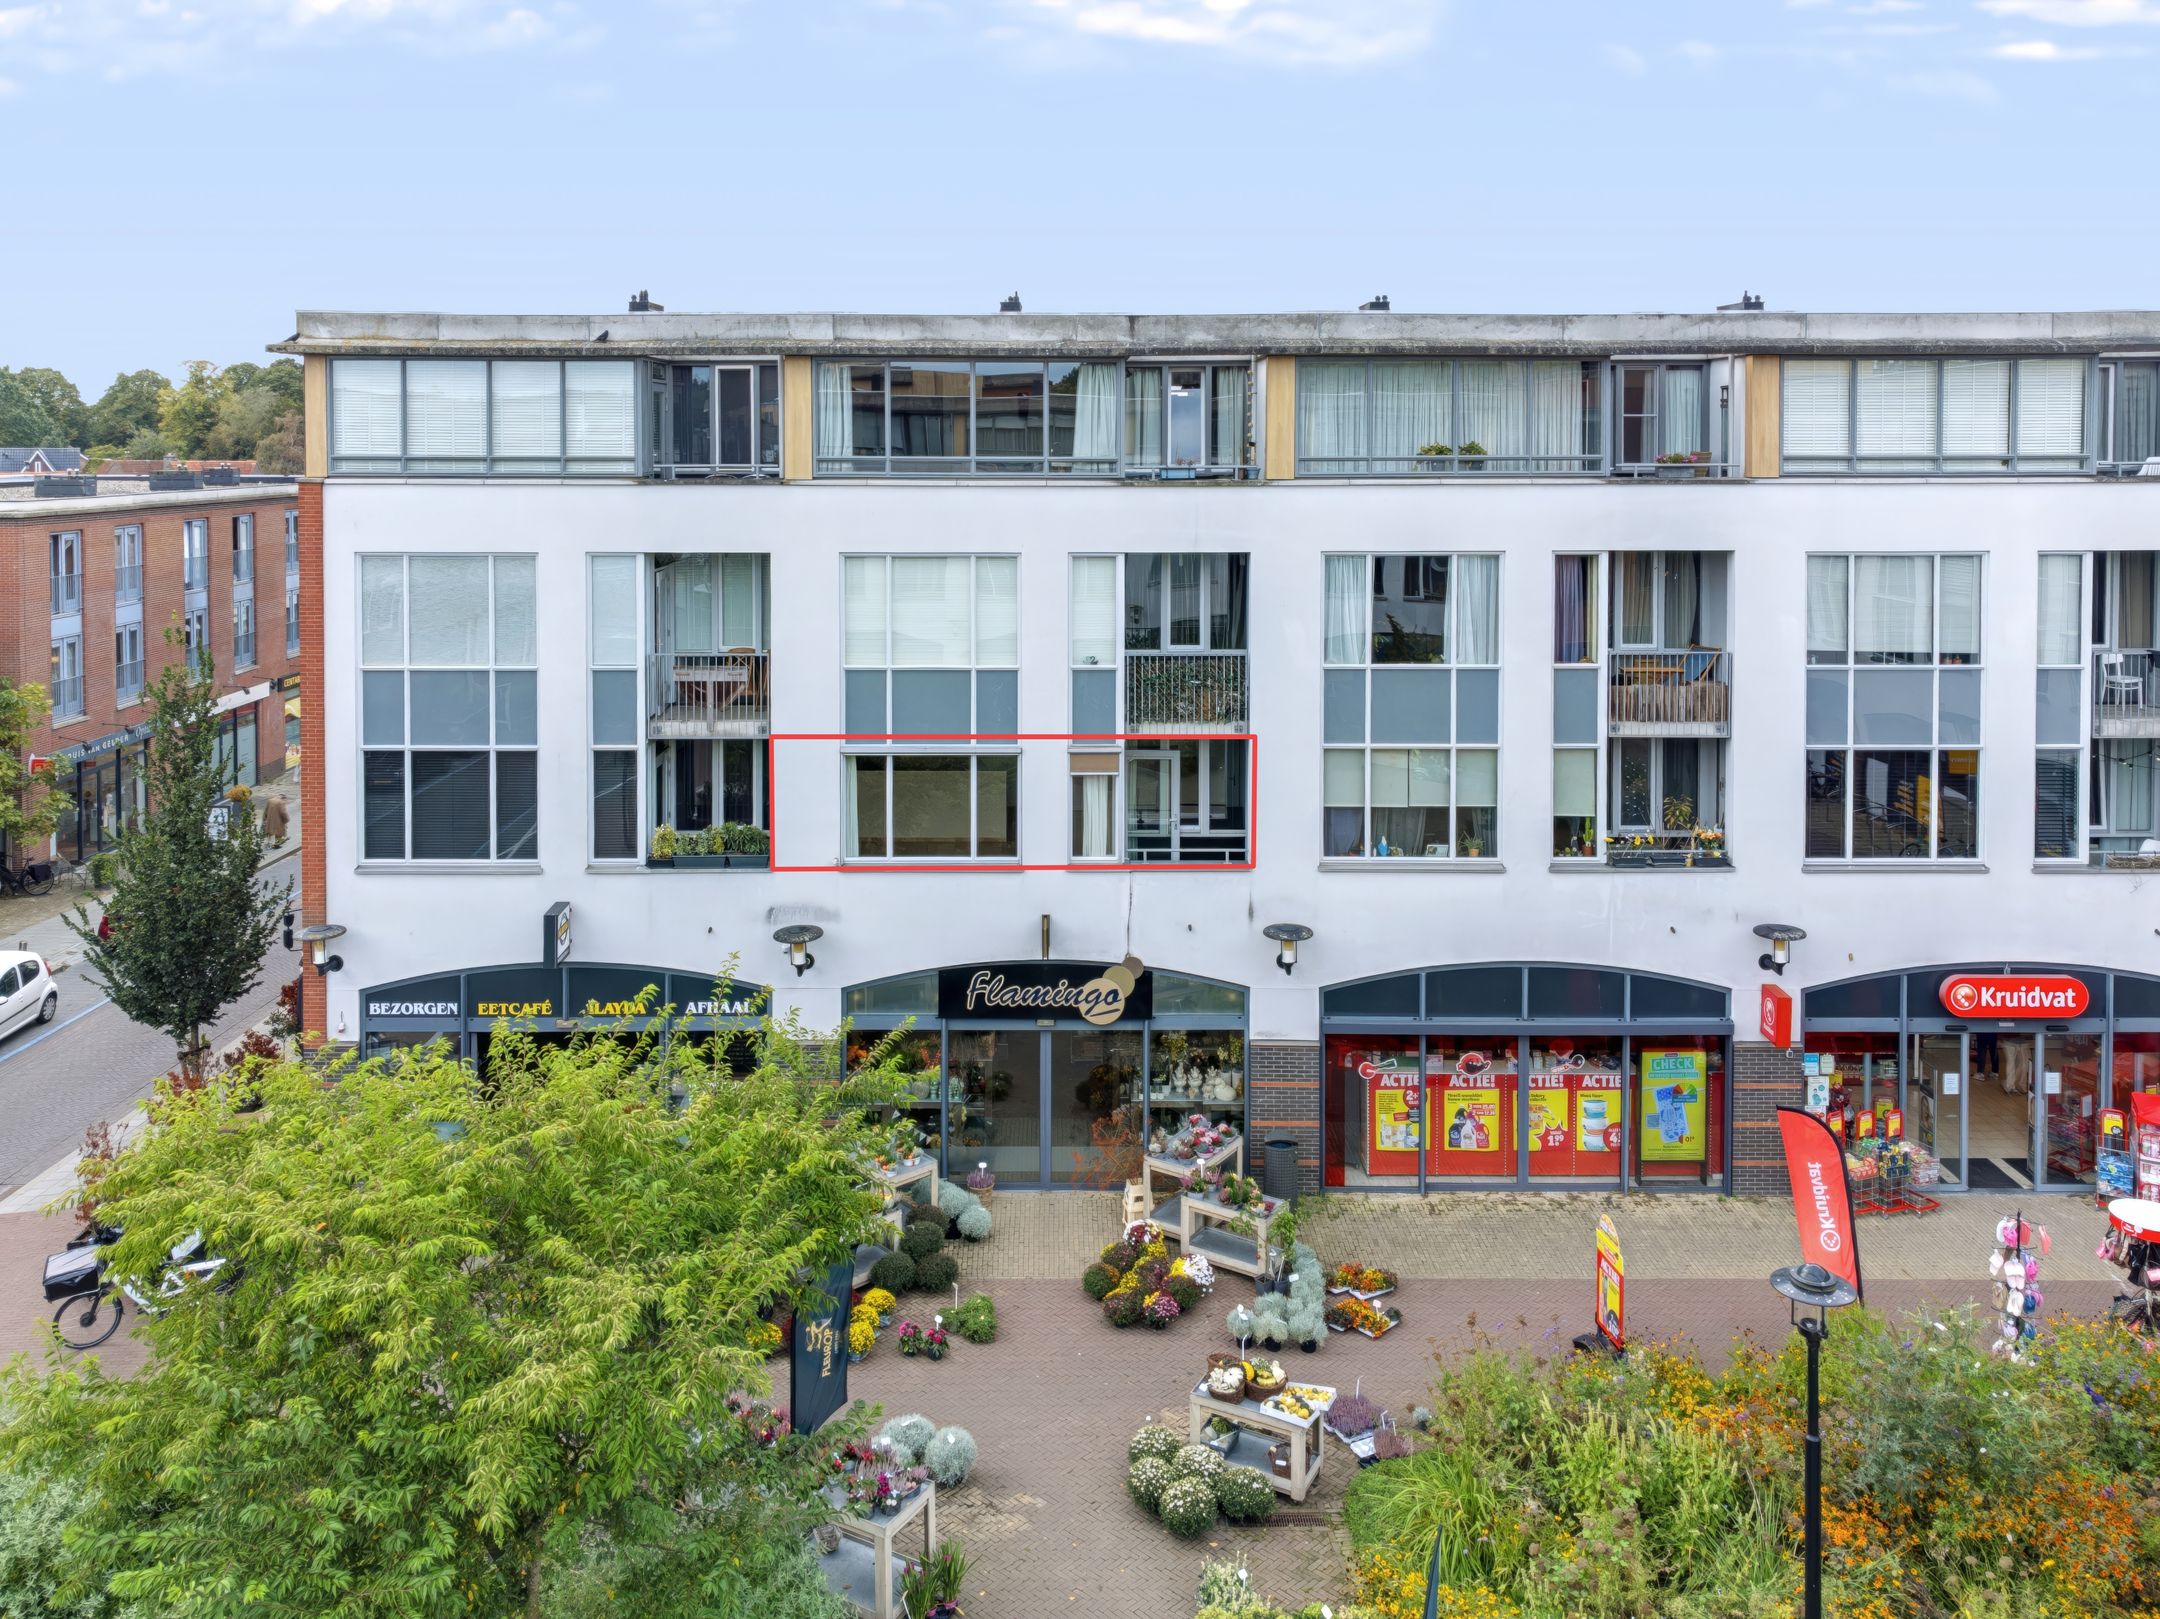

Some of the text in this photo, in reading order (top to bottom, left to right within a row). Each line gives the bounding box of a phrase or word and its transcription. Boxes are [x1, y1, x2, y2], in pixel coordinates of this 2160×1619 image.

[966, 970, 1122, 1016] Flamingo
[1981, 986, 2077, 1008] Kruidvat
[369, 1002, 458, 1015] BEZORGEN
[478, 1000, 552, 1015] EETCAFÉ
[1653, 1057, 1693, 1070] CHECK
[1449, 1074, 1496, 1088] ACTIE!
[1528, 1075, 1564, 1088] CTIE!
[822, 1329, 833, 1378] FLEUROP
